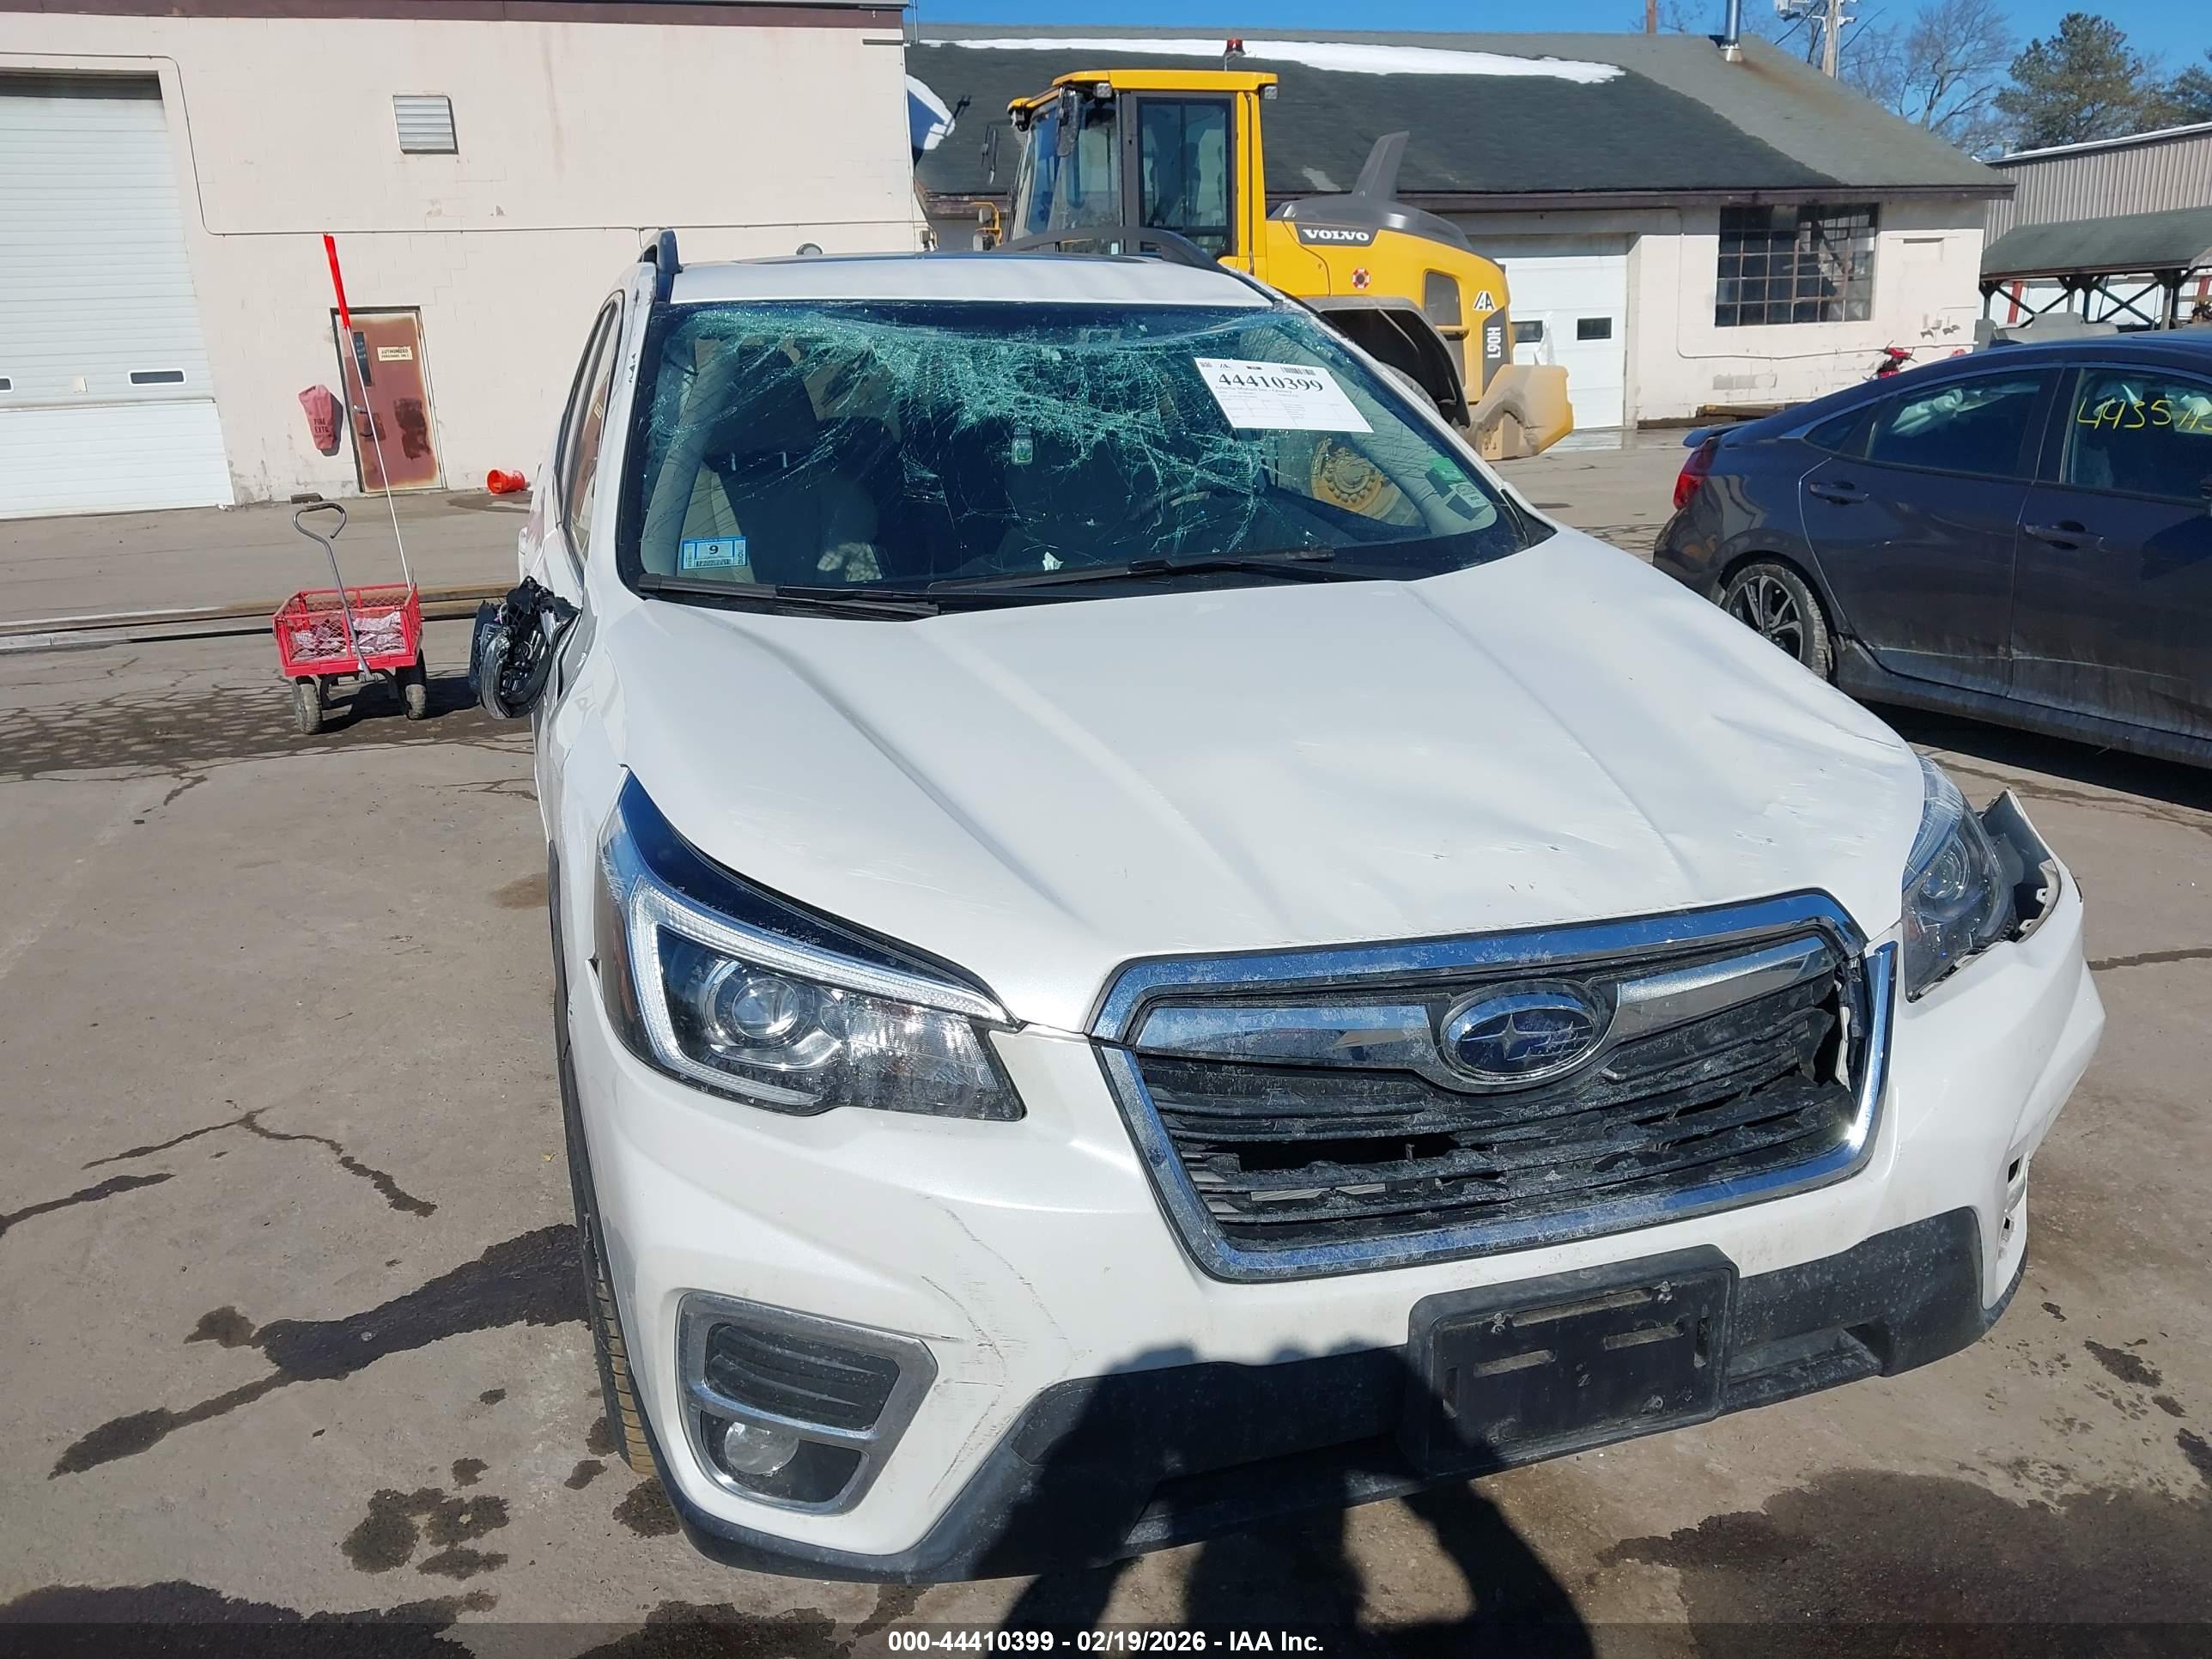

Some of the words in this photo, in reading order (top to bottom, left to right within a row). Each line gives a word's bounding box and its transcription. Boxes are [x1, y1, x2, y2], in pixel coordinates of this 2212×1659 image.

[1302, 229, 1370, 241] VOLVO
[1486, 327, 1502, 359] L90H
[1218, 374, 1323, 392] 44410399
[708, 544, 720, 555] 9
